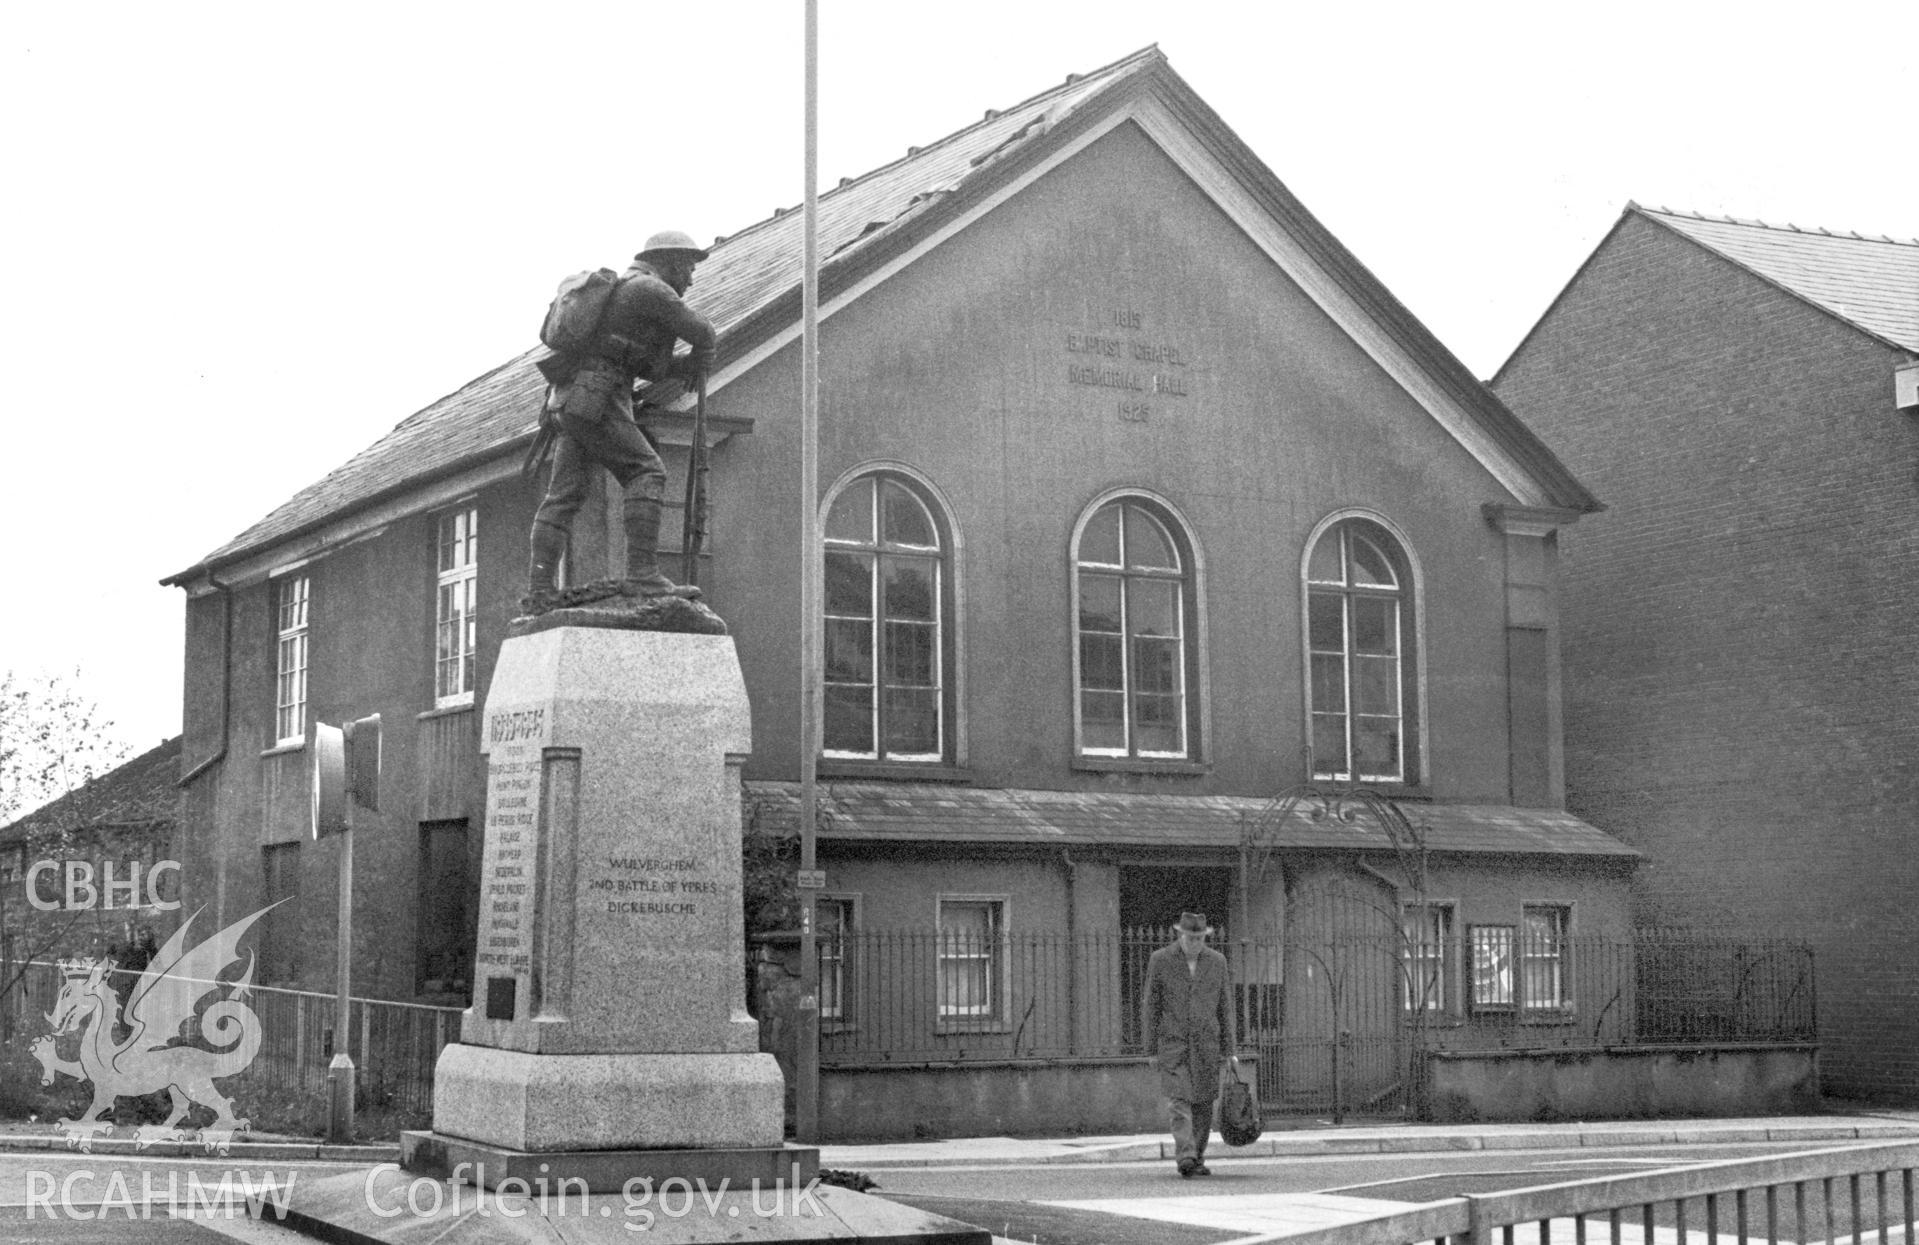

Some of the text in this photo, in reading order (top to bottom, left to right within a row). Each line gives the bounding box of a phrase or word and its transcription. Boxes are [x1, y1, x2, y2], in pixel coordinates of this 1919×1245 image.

[617, 880, 658, 892] BATTLE
[662, 881, 678, 892] OF
[681, 881, 718, 894] YPRES
[608, 901, 696, 915] DICKEBUSCHE
